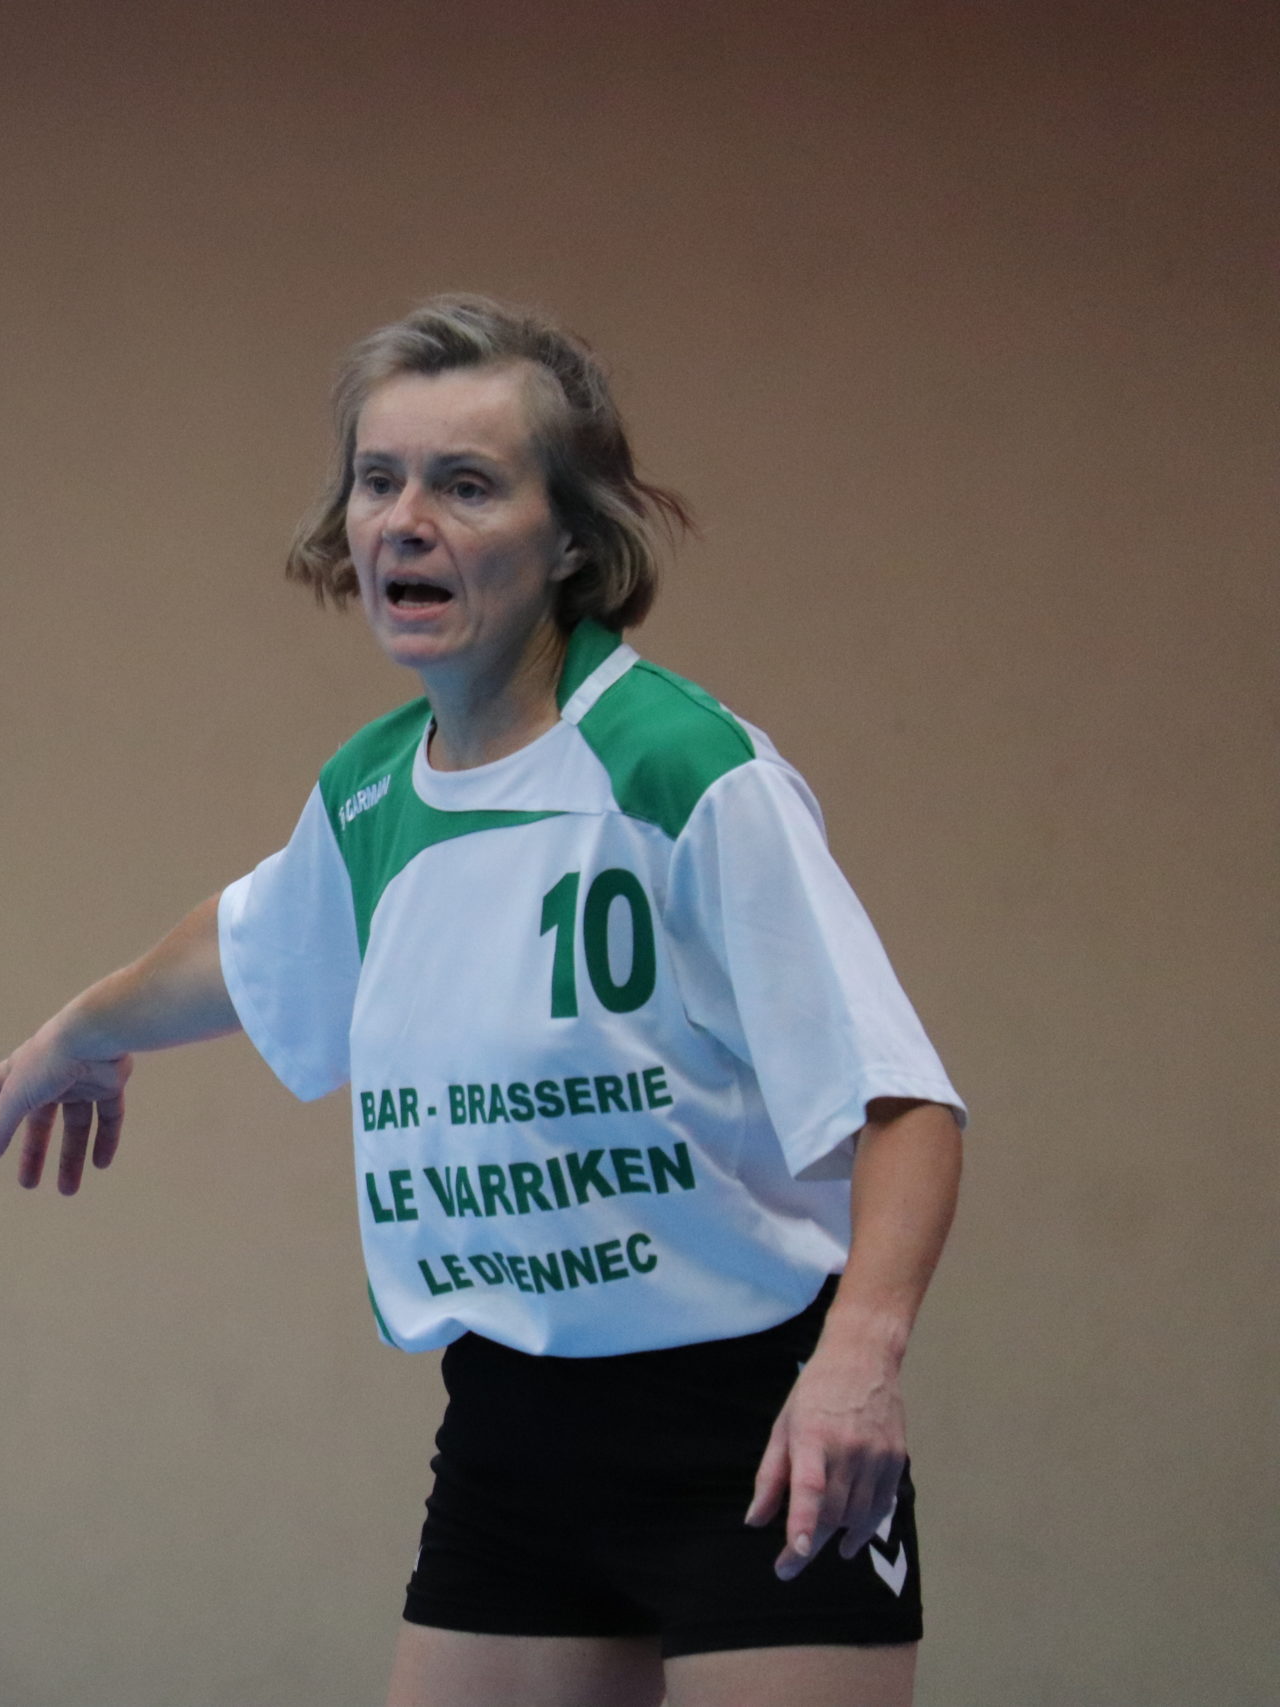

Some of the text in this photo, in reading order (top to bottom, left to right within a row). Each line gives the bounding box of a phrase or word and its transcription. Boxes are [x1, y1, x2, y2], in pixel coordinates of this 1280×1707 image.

[540, 868, 656, 1018] 10
[448, 1066, 673, 1126] BRASSERIE
[365, 1142, 696, 1224] LE VARRIKEN
[418, 1254, 474, 1296] LE
